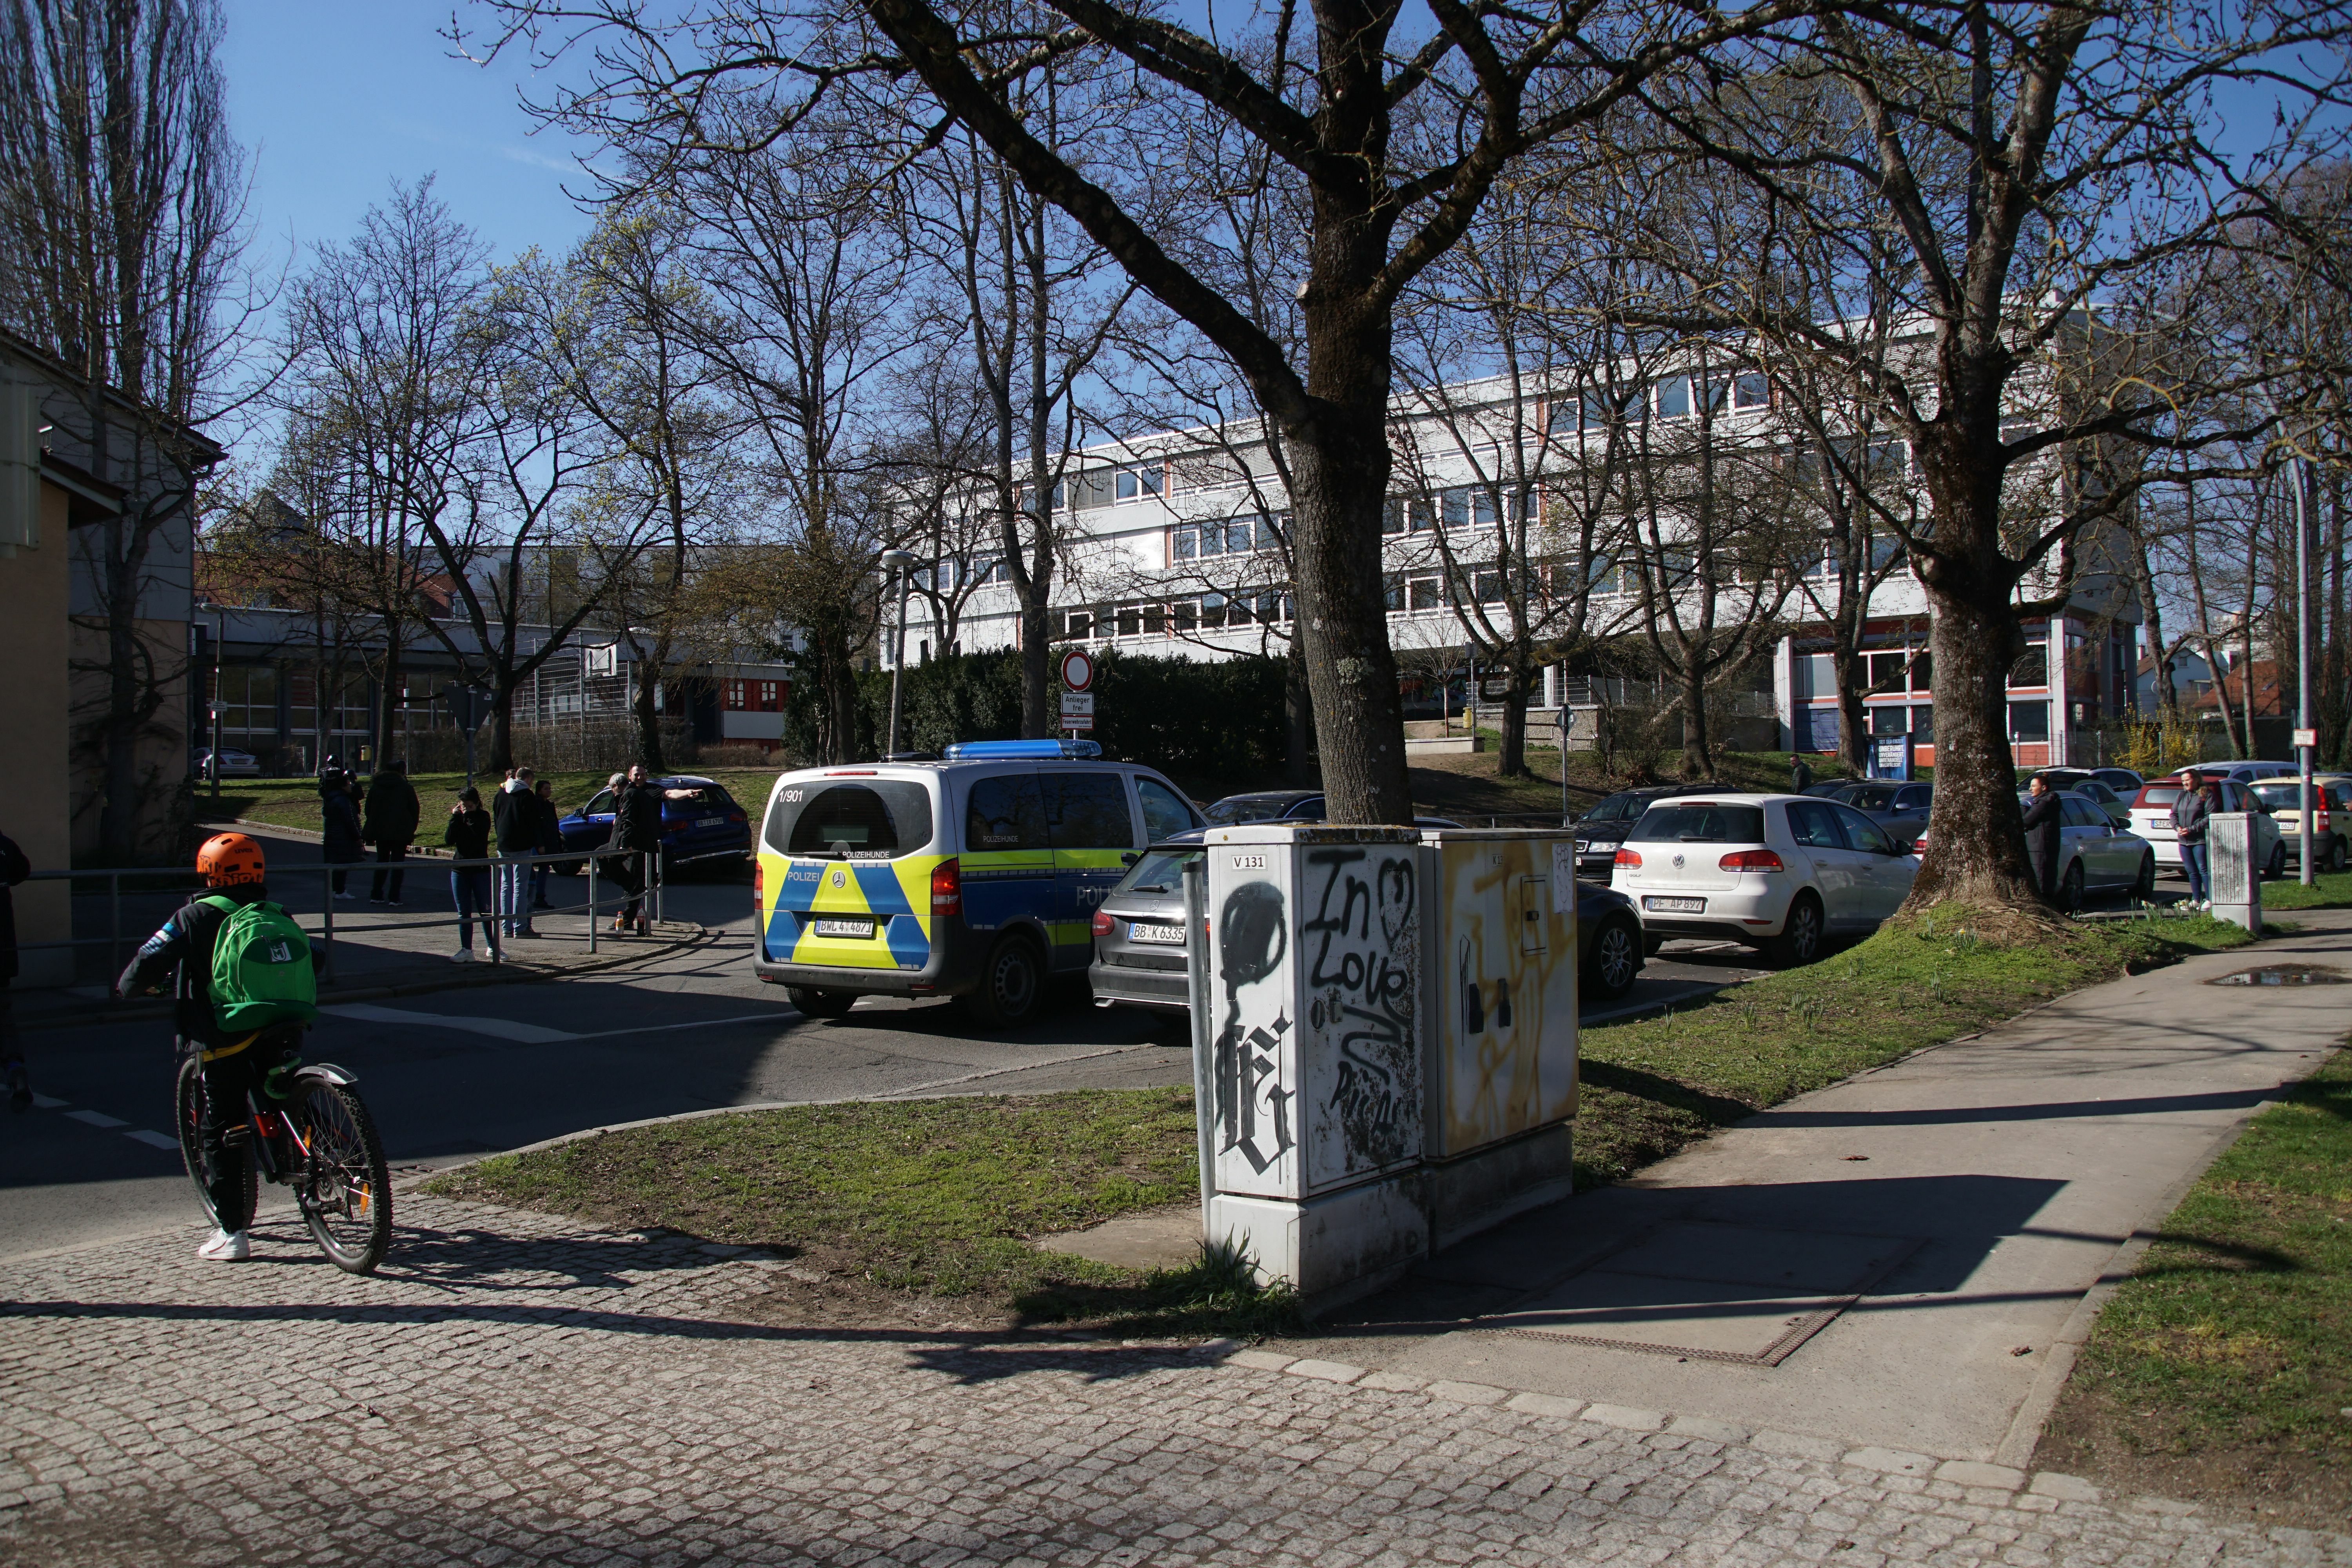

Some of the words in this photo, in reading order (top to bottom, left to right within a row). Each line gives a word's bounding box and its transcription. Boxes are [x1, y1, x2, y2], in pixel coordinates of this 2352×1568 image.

[1065, 696, 1090, 704] Anlieger
[780, 790, 803, 802] 1/901
[1234, 857, 1241, 867] V
[1245, 857, 1264, 867] 131
[1493, 856, 1496, 864] K
[788, 871, 820, 882] POLIZEI
[1653, 898, 1664, 908] PF
[1670, 899, 1683, 908] AP
[1684, 900, 1701, 909] 897
[821, 920, 837, 931] BWL
[839, 920, 844, 932] 4
[850, 920, 871, 933] 4871
[1134, 926, 1146, 938] BB
[1152, 926, 1159, 939] K
[1160, 927, 1185, 940] 6335
